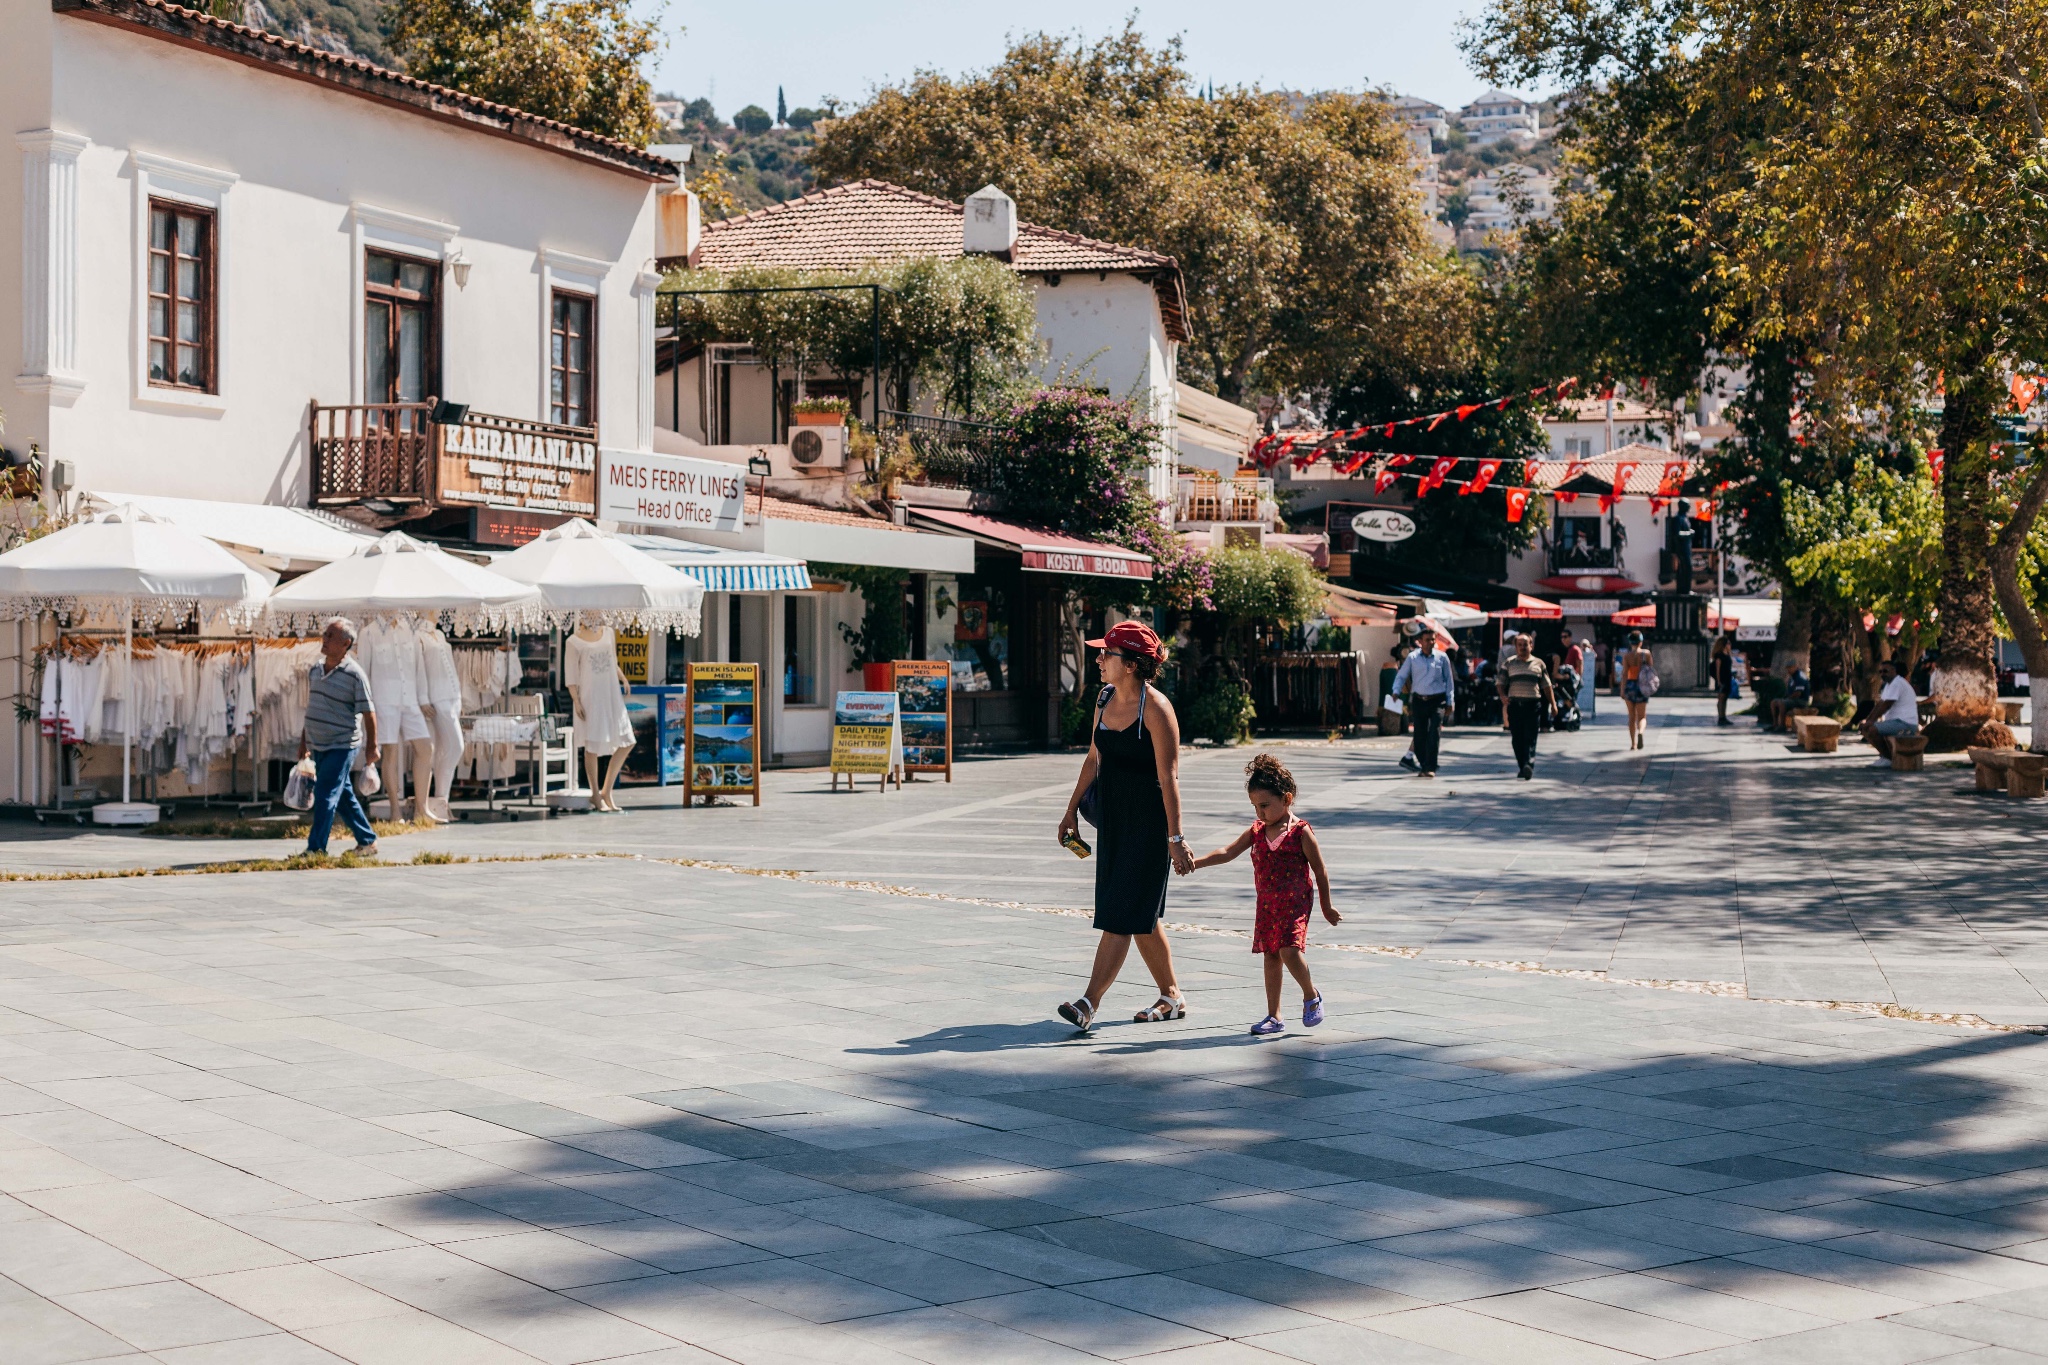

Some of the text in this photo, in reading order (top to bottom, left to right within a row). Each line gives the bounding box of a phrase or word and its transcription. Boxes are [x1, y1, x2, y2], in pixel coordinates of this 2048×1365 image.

[445, 424, 595, 471] KAHRAMANLAR
[505, 464, 574, 484] & SHIPPING CO.
[610, 463, 739, 500] MEIS FERRY LINES
[481, 476, 561, 497] MEIS HEAD OFFICE
[638, 497, 712, 523] Head Office
[1046, 553, 1129, 575] KOSTA BODA
[616, 643, 648, 657] FERRY
[845, 703, 885, 711] EVERYDAY
[840, 726, 865, 734] DAILY
